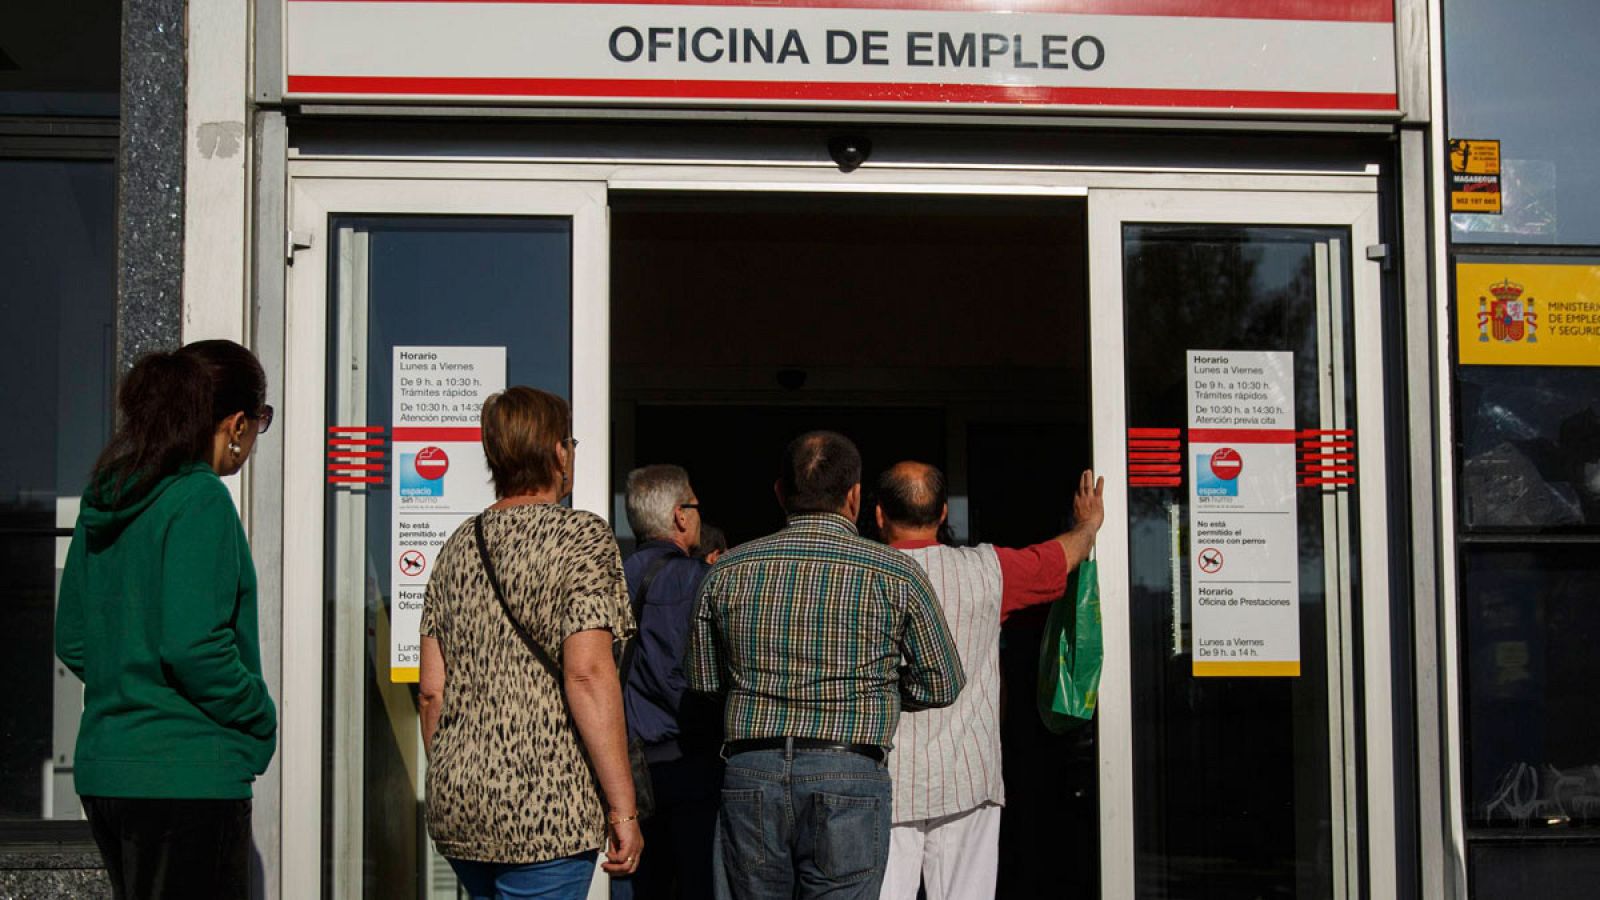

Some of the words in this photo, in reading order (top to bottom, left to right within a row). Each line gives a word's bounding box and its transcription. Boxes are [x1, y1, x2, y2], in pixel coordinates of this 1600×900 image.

[608, 25, 810, 64] OFICINA
[826, 29, 889, 65] DE
[907, 31, 1105, 71] EMPLEO
[1548, 302, 1600, 312] MINISTERI
[1549, 314, 1563, 323] DE
[1566, 314, 1600, 324] EMPLE
[1549, 326, 1556, 336] Y
[400, 352, 437, 360] Horario
[1194, 355, 1229, 364] Horario
[1194, 366, 1220, 374] Lunes
[1231, 366, 1264, 374] Viernes
[400, 378, 413, 386] De
[416, 378, 421, 386] 9
[447, 378, 471, 386] 10:30
[1195, 381, 1207, 389] De
[1210, 381, 1215, 389] 9
[1238, 381, 1261, 389] 10:30
[400, 388, 440, 397] Trámites
[443, 388, 478, 398] rápidos
[1195, 391, 1232, 400] Trámites
[1235, 391, 1268, 401] rápidos
[400, 403, 412, 411] De
[416, 403, 440, 411] 10:30
[1195, 405, 1207, 413] De
[1210, 405, 1232, 413] 10:30
[1252, 405, 1275, 414] 14:30
[400, 413, 439, 422] Atención
[441, 414, 467, 423] previa
[469, 413, 481, 422] cit
[1195, 415, 1232, 424] Atención
[1234, 416, 1259, 425] previa
[1260, 416, 1276, 424] cita
[401, 486, 432, 496] espacio
[1199, 487, 1227, 496] espacio
[1198, 520, 1208, 528] No
[1209, 520, 1226, 528] está
[1234, 528, 1241, 536] el
[1199, 588, 1233, 596] Horario
[399, 601, 423, 609] Oficin
[1199, 597, 1226, 606] Oficina
[1228, 597, 1238, 606] de
[1240, 598, 1290, 606] Prestaciones
[1200, 638, 1224, 646] Lunes
[1233, 638, 1264, 646] Viernes
[398, 643, 420, 651] Lune
[1200, 648, 1211, 656] De
[1213, 648, 1219, 656] 9
[1239, 648, 1249, 656] 14
[398, 653, 411, 662] De
[412, 653, 418, 662] 9
